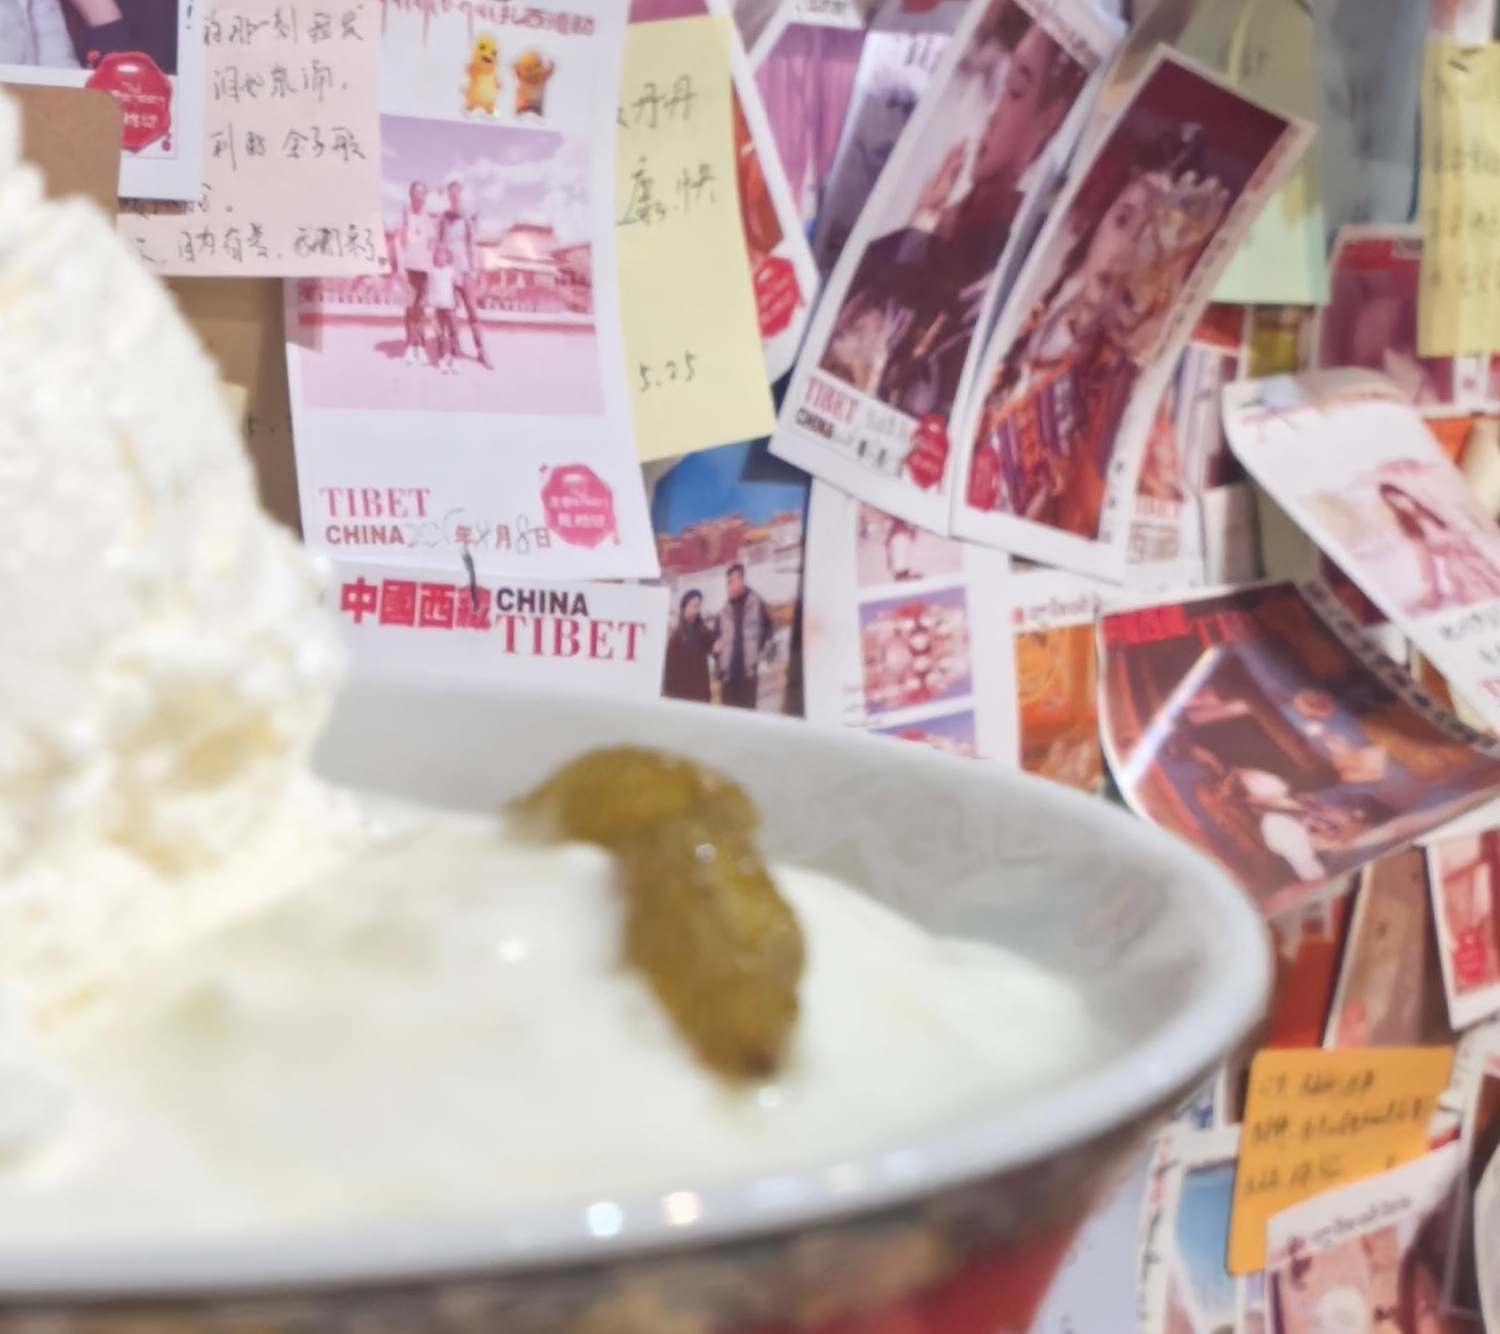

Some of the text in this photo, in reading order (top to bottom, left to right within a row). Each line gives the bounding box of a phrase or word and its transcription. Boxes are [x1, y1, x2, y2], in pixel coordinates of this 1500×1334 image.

[318, 487, 432, 520] TIBET
[325, 524, 405, 547] CHINA
[496, 587, 590, 617] CHINA
[496, 613, 648, 662] TIBET
